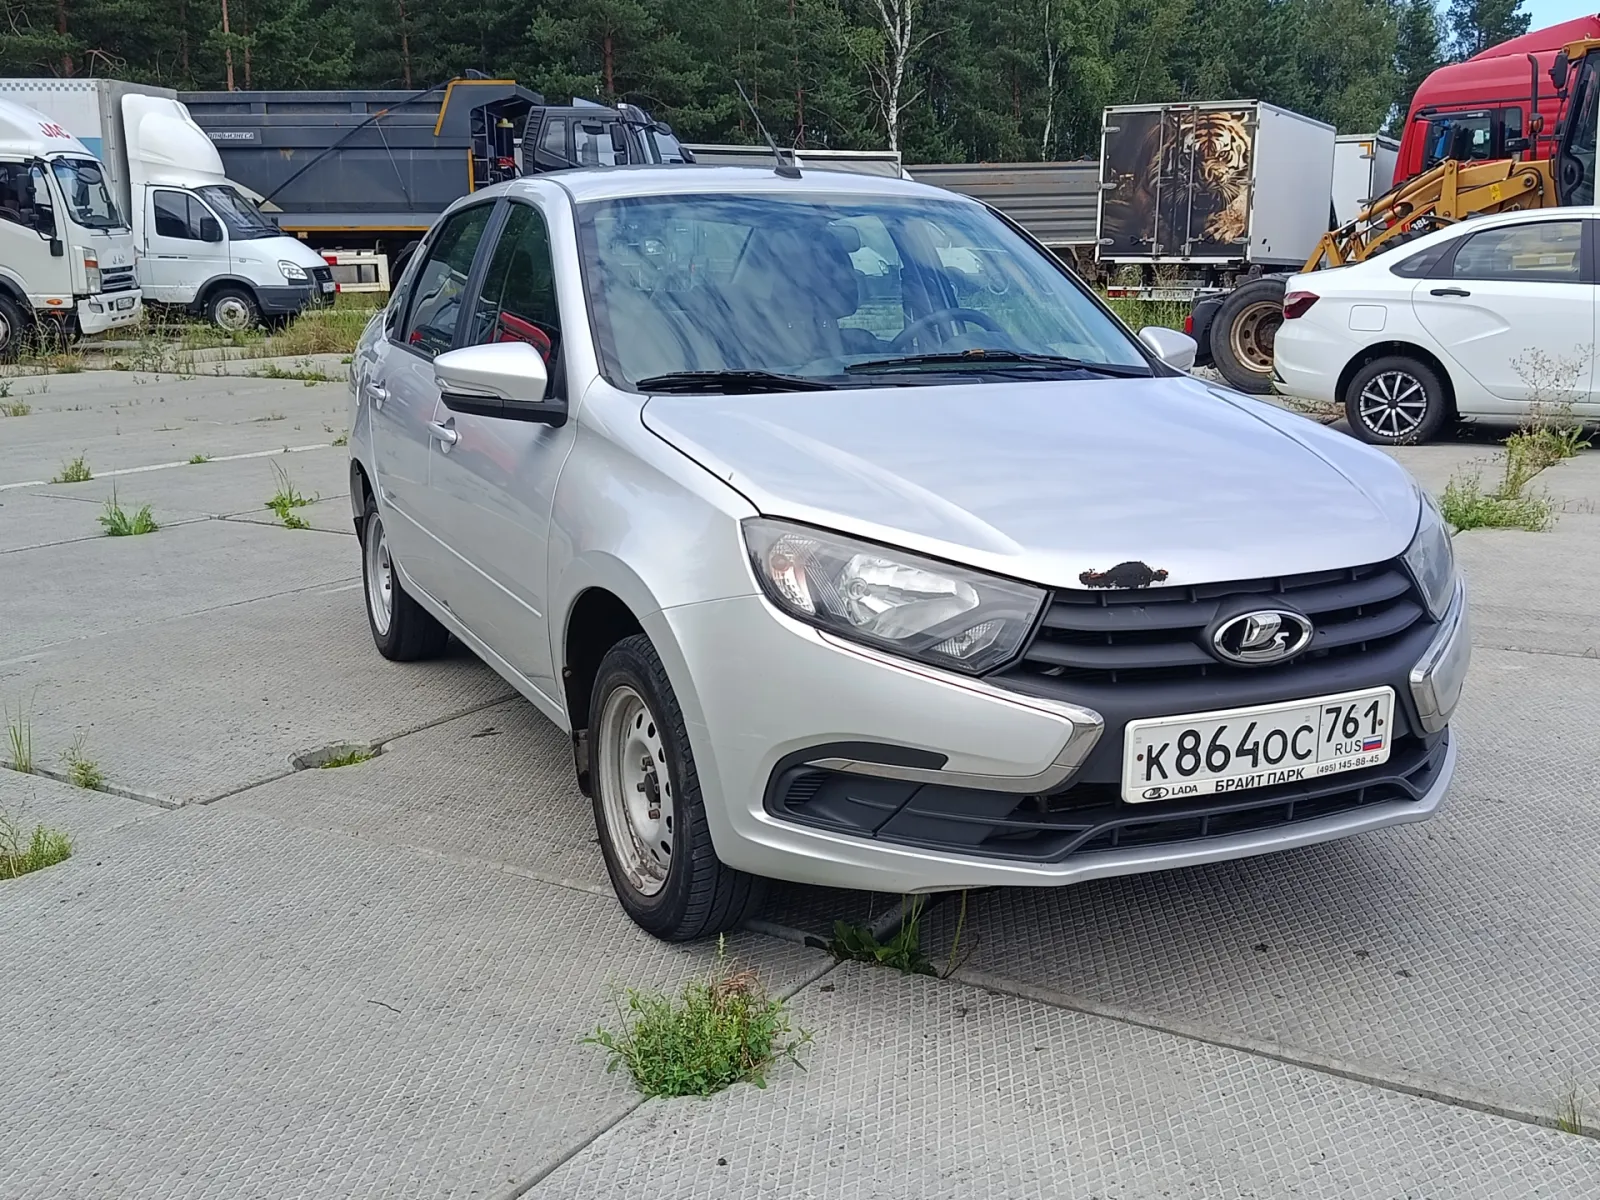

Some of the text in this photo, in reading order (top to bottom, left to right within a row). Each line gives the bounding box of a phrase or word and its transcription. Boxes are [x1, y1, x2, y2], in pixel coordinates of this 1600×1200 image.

[38, 122, 71, 139] JAC
[1145, 699, 1380, 782] К864ОС 761
[1334, 739, 1362, 756] RUS
[1214, 754, 1380, 792] БРАЙТ ПАРК (495) 145-88-45
[1171, 784, 1198, 796] LADA
